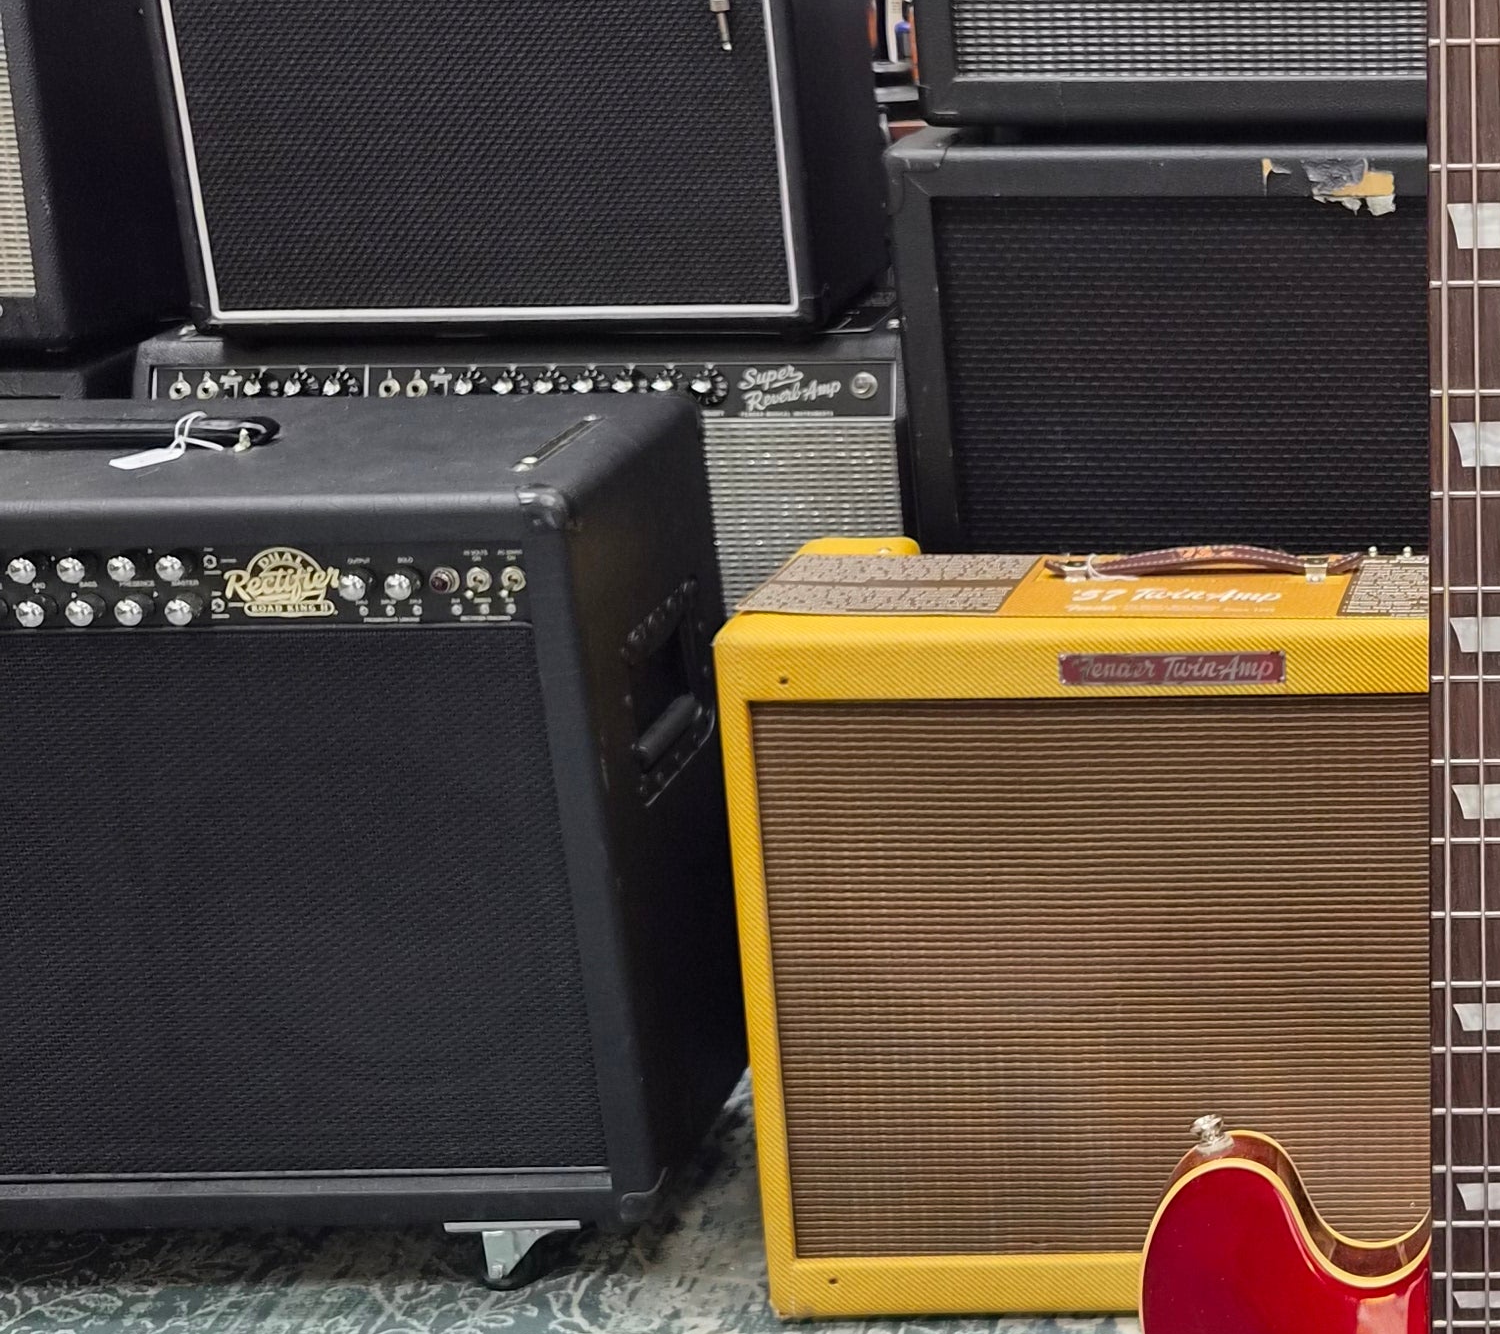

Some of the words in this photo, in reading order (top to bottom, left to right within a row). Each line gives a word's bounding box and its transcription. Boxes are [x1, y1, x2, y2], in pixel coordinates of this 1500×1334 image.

[737, 365, 804, 391] Super
[257, 552, 303, 569] DUAL
[223, 566, 340, 602] Rectifier
[252, 603, 283, 613] ROAD
[1163, 653, 1275, 681] Twin-Amp
